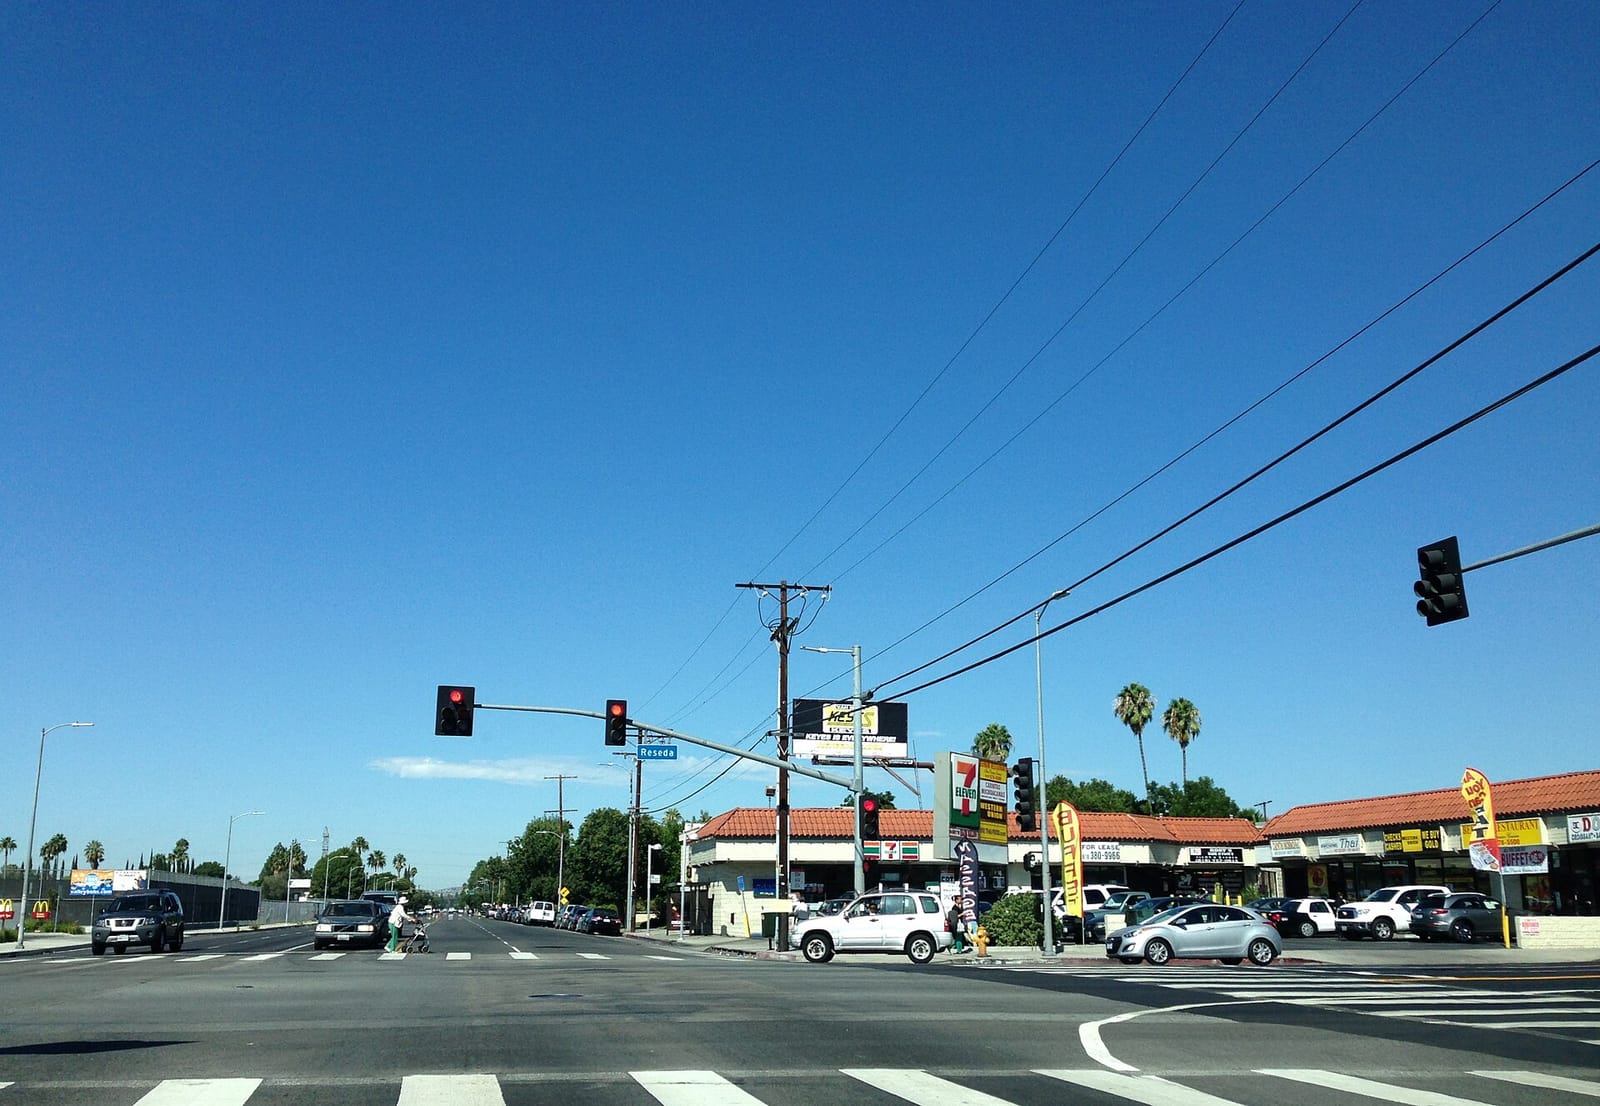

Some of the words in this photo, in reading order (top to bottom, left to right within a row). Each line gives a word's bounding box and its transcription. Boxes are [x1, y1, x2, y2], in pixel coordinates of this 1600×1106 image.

[641, 748, 674, 757] Reseda
[1340, 837, 1359, 849] Thai
[1425, 840, 1438, 849] GOLD
